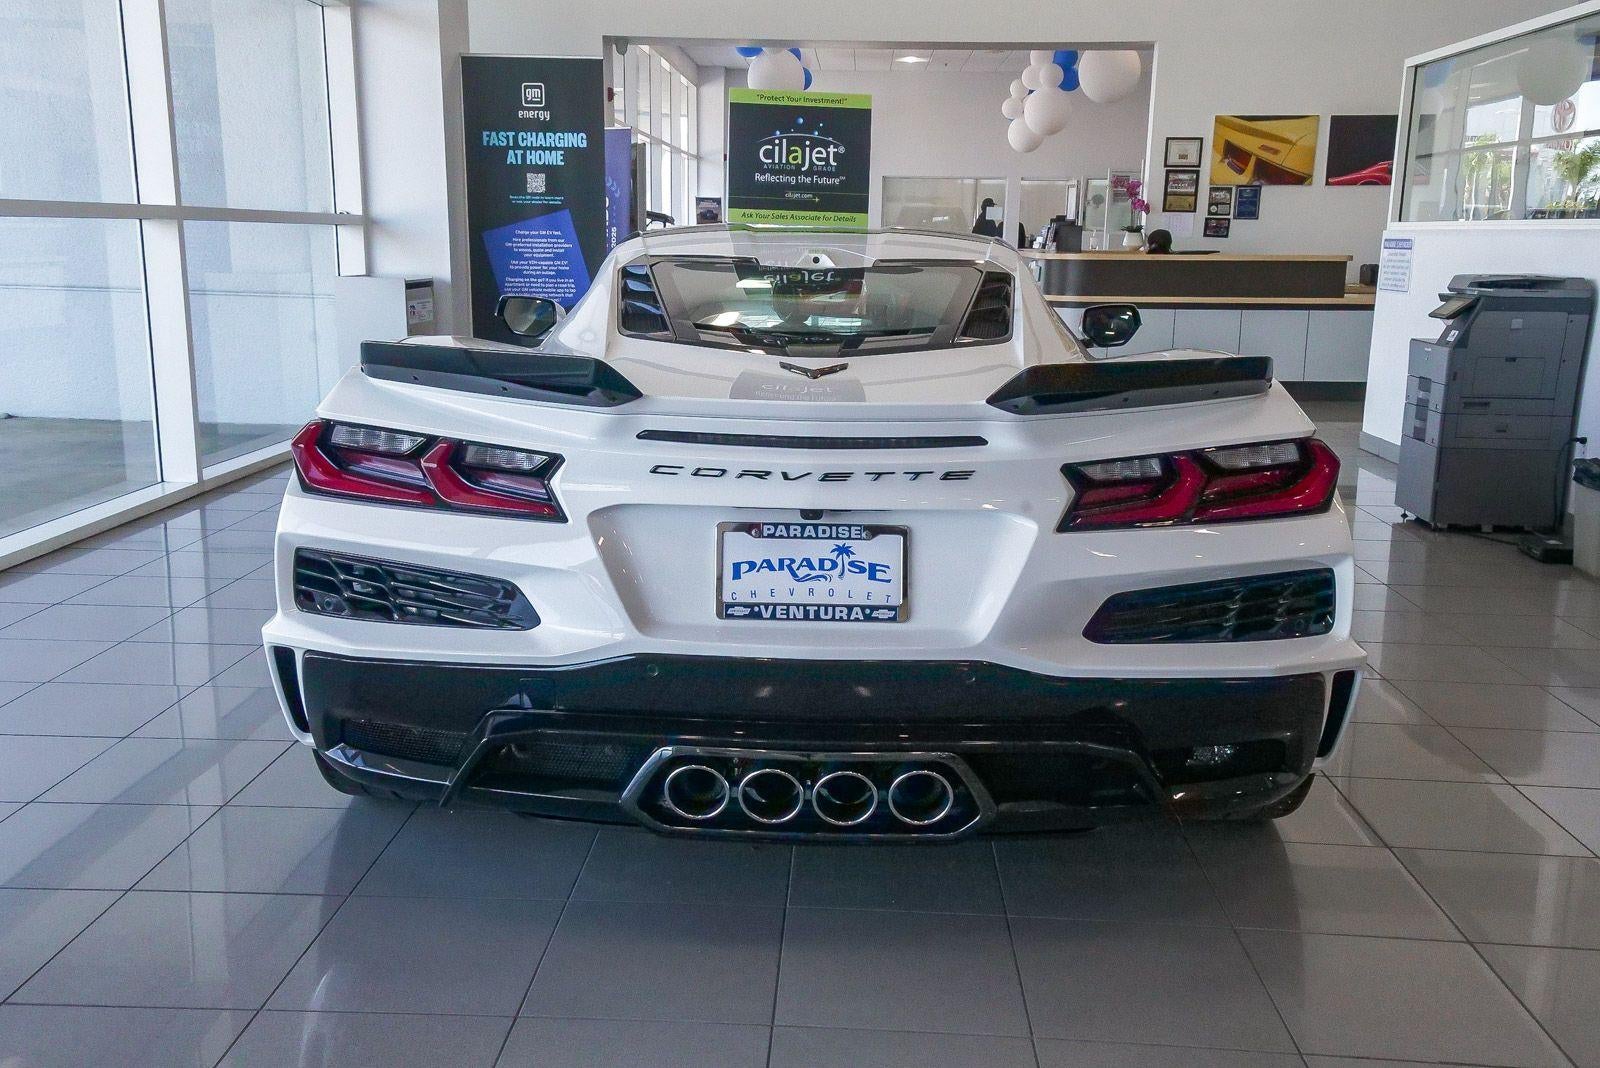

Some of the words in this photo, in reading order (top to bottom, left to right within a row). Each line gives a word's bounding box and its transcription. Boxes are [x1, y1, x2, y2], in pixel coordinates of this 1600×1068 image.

[525, 88, 541, 101] gm
[786, 95, 802, 103] Your
[518, 110, 550, 121] energy
[482, 131, 516, 146] FAST
[518, 131, 588, 148] CHARGING
[506, 149, 524, 165] AT
[526, 150, 565, 166] HOME
[754, 172, 796, 185] Reflecting
[797, 174, 812, 184] the
[754, 212, 771, 220] Your
[771, 212, 789, 220] Sales
[789, 213, 822, 221] Associate
[822, 214, 831, 222] for
[648, 464, 977, 483] CORVETTE
[762, 524, 862, 539] PARADISE
[731, 547, 892, 584] PARADISE
[731, 586, 892, 604] CHEVROLET
[759, 604, 865, 621] VENTURA
